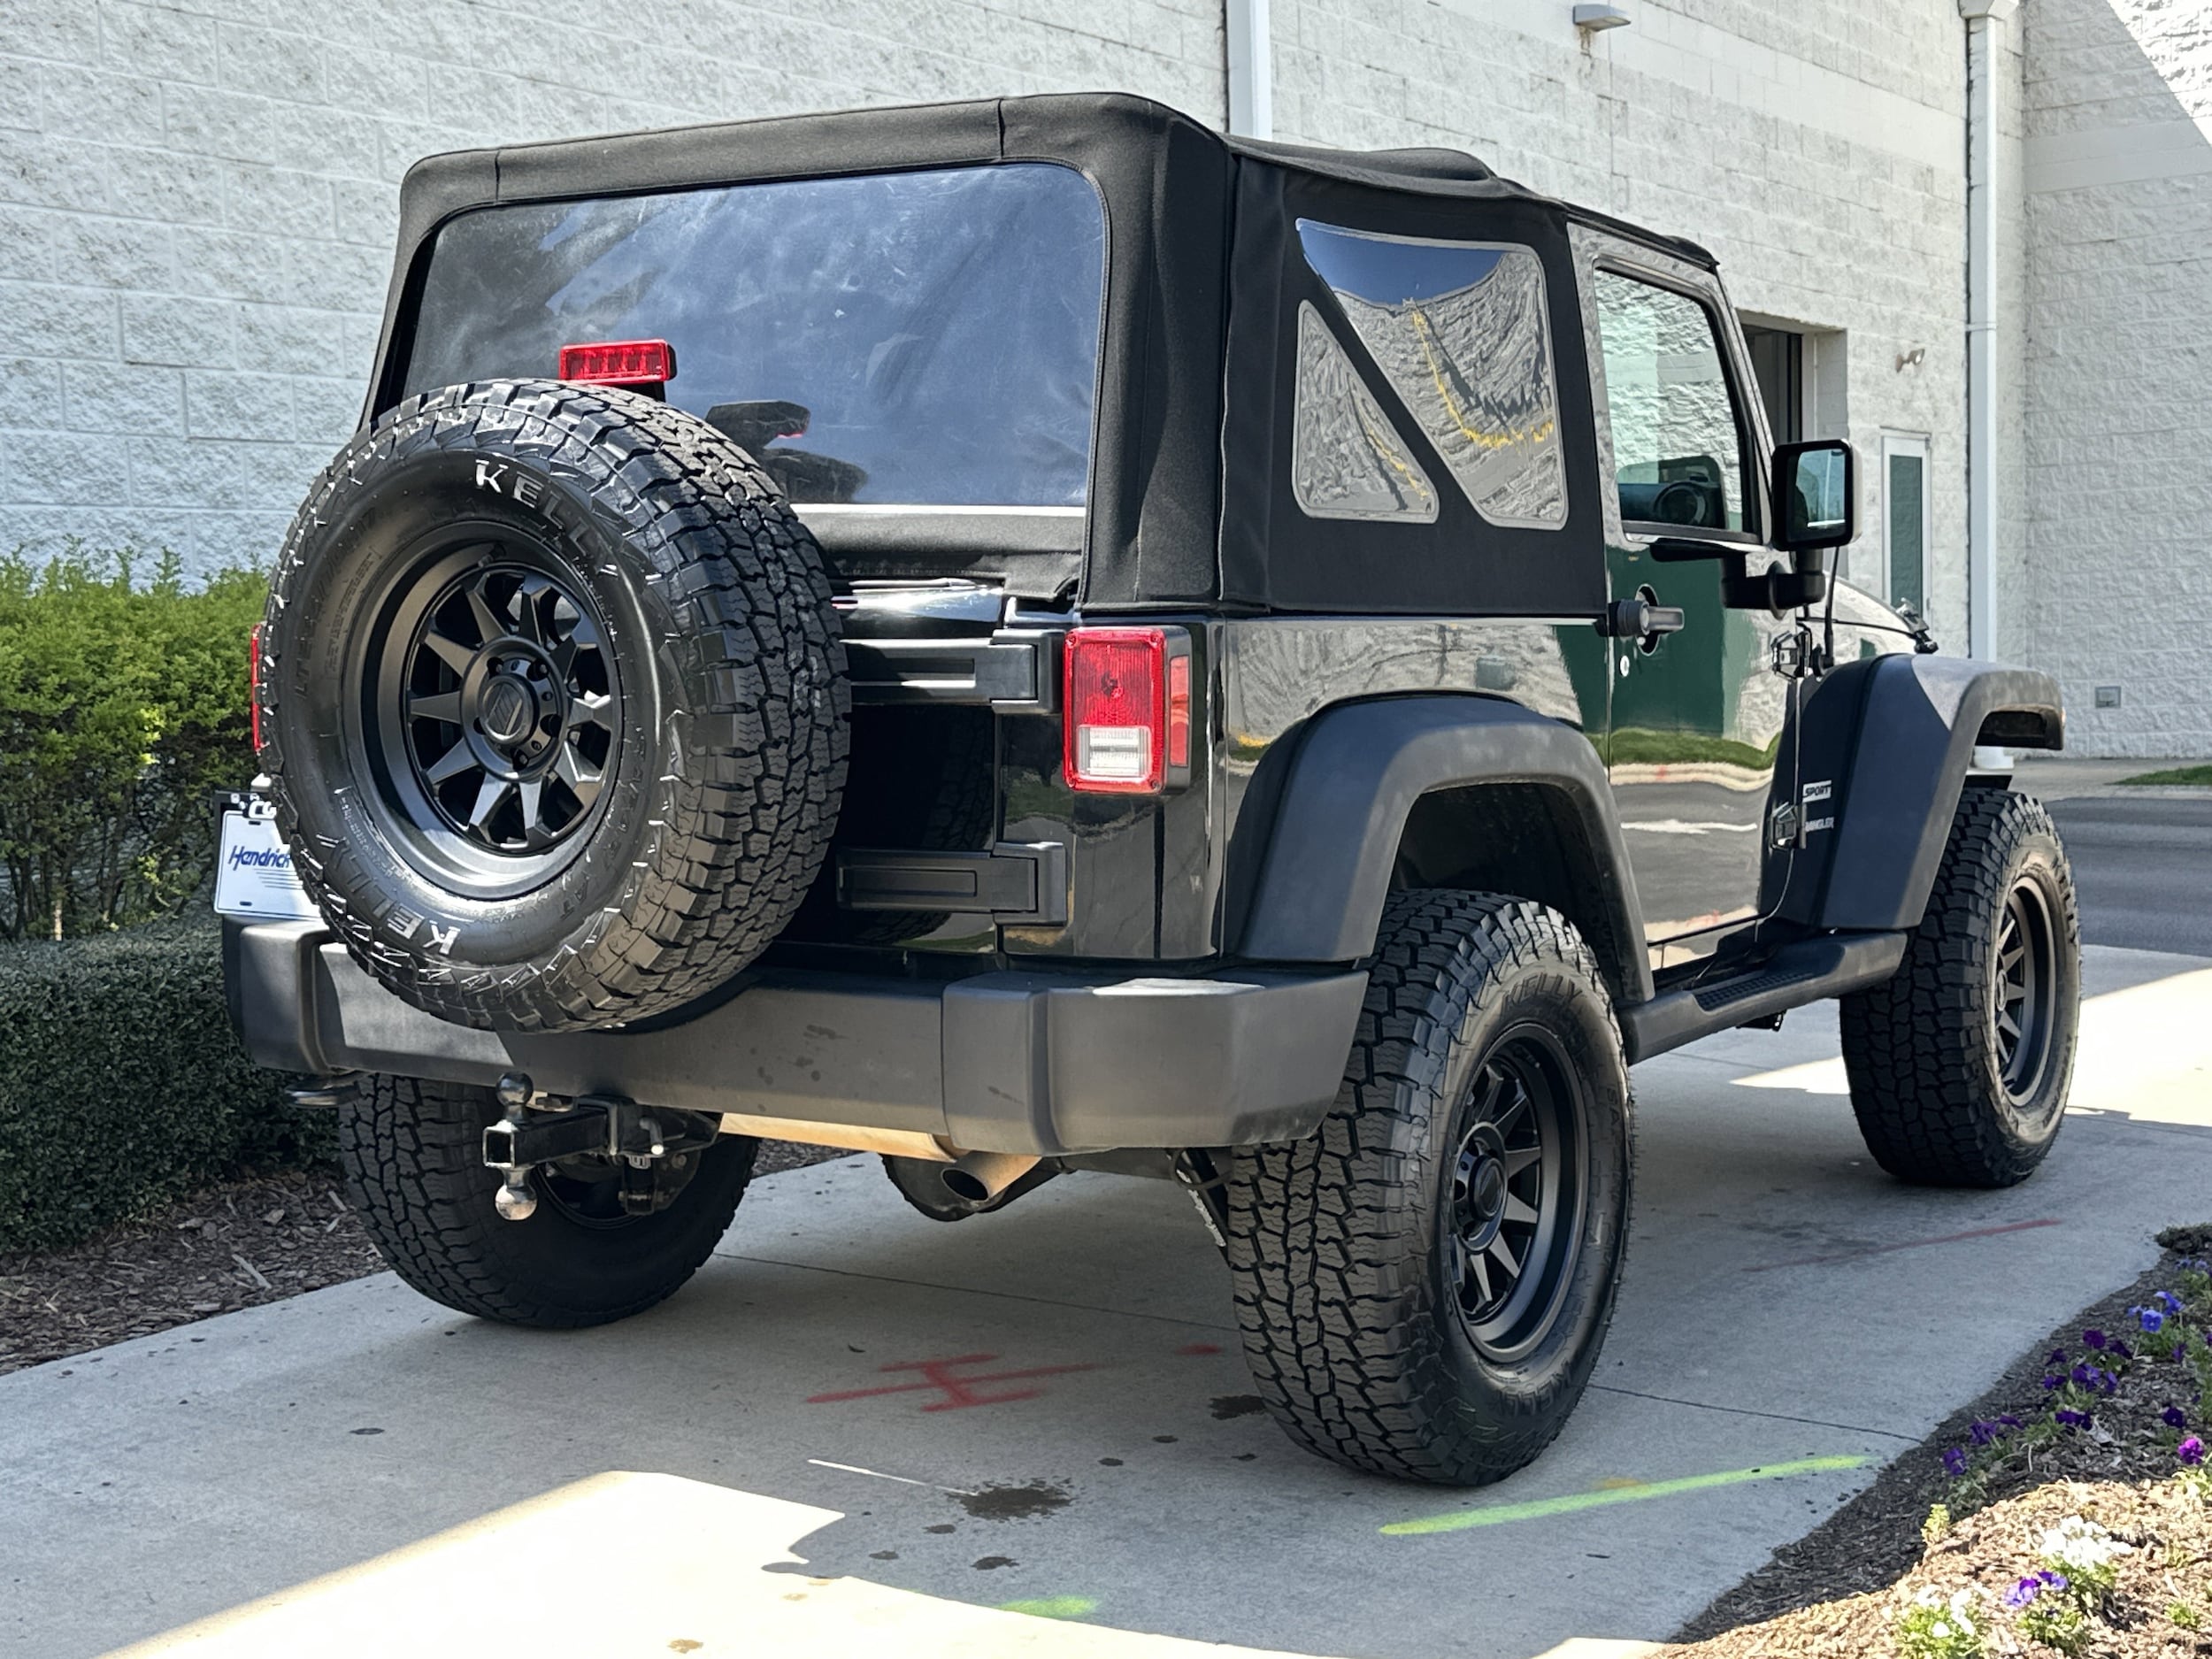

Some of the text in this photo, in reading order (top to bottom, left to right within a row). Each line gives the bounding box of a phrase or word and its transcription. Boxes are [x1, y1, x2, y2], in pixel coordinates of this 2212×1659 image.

[1803, 783, 1832, 799] SPORT
[228, 845, 289, 871] Hendrick
[1502, 972, 1583, 1013] KELLY
